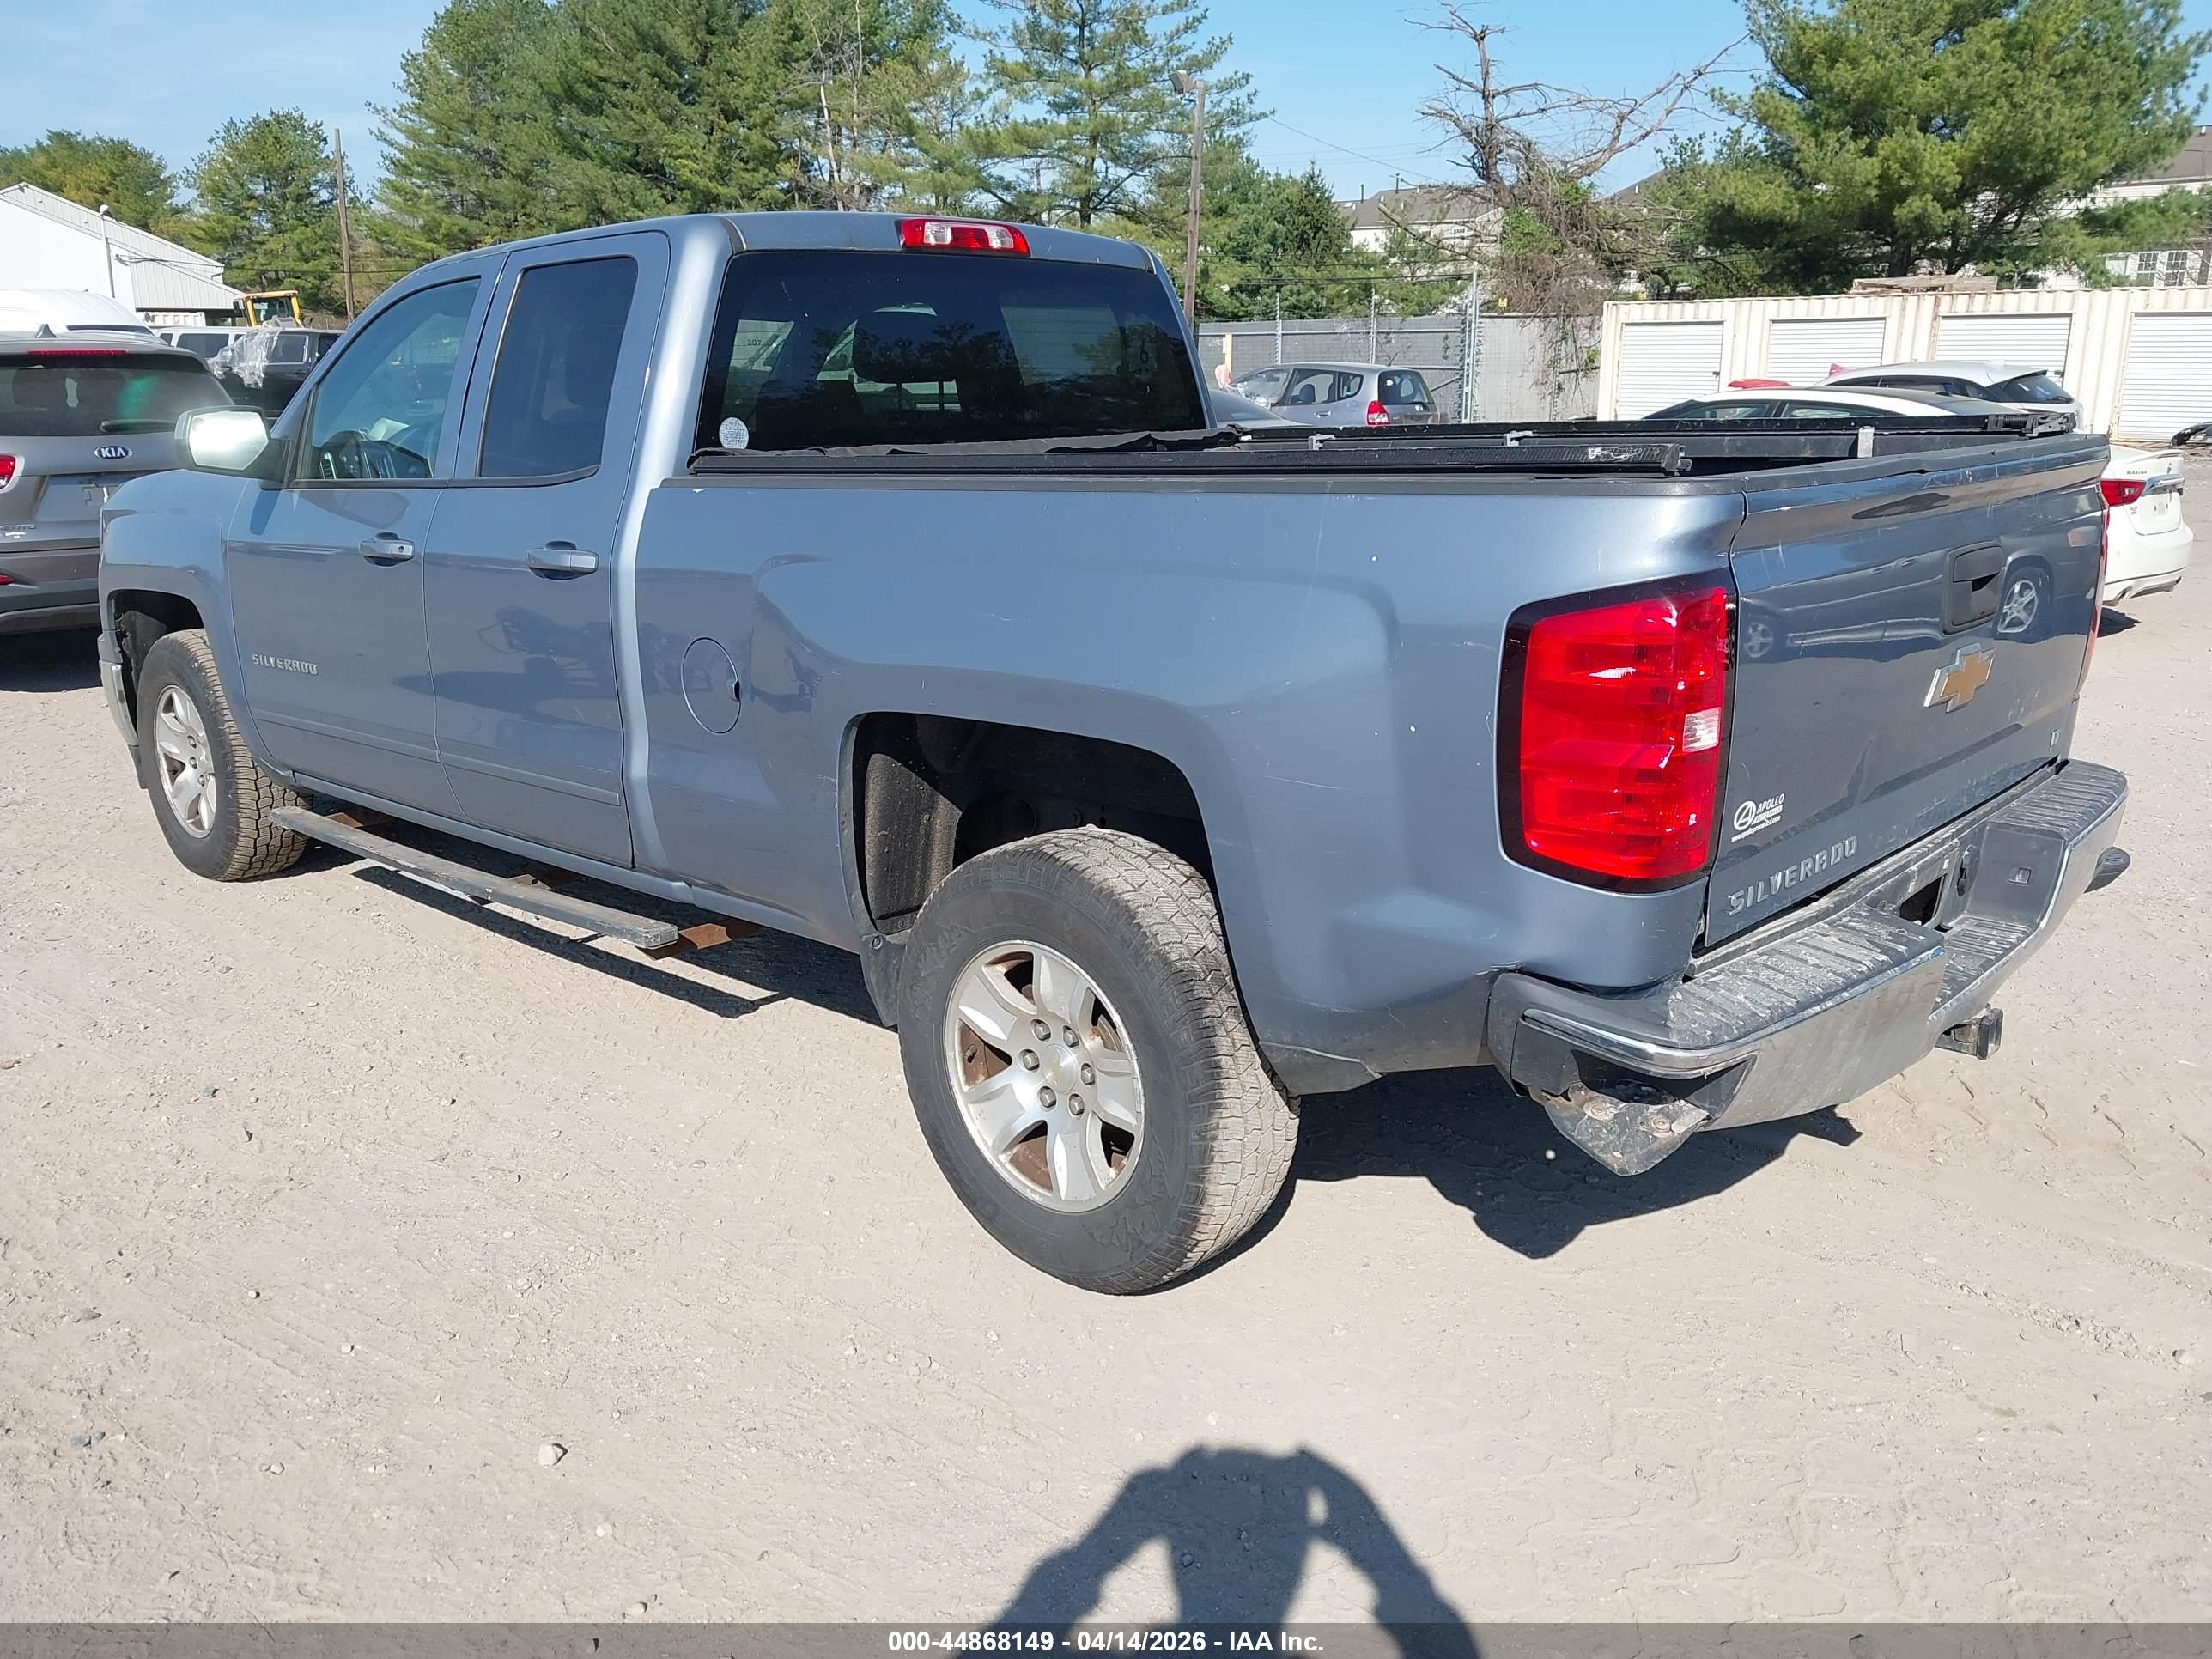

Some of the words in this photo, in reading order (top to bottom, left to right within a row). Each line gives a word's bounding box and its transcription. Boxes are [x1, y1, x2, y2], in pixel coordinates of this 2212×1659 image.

[101, 447, 126, 458] KIA
[252, 653, 318, 675] SILVERADO
[1756, 793, 1785, 815] APOLLO
[1728, 836, 1857, 916] SILVERADO
